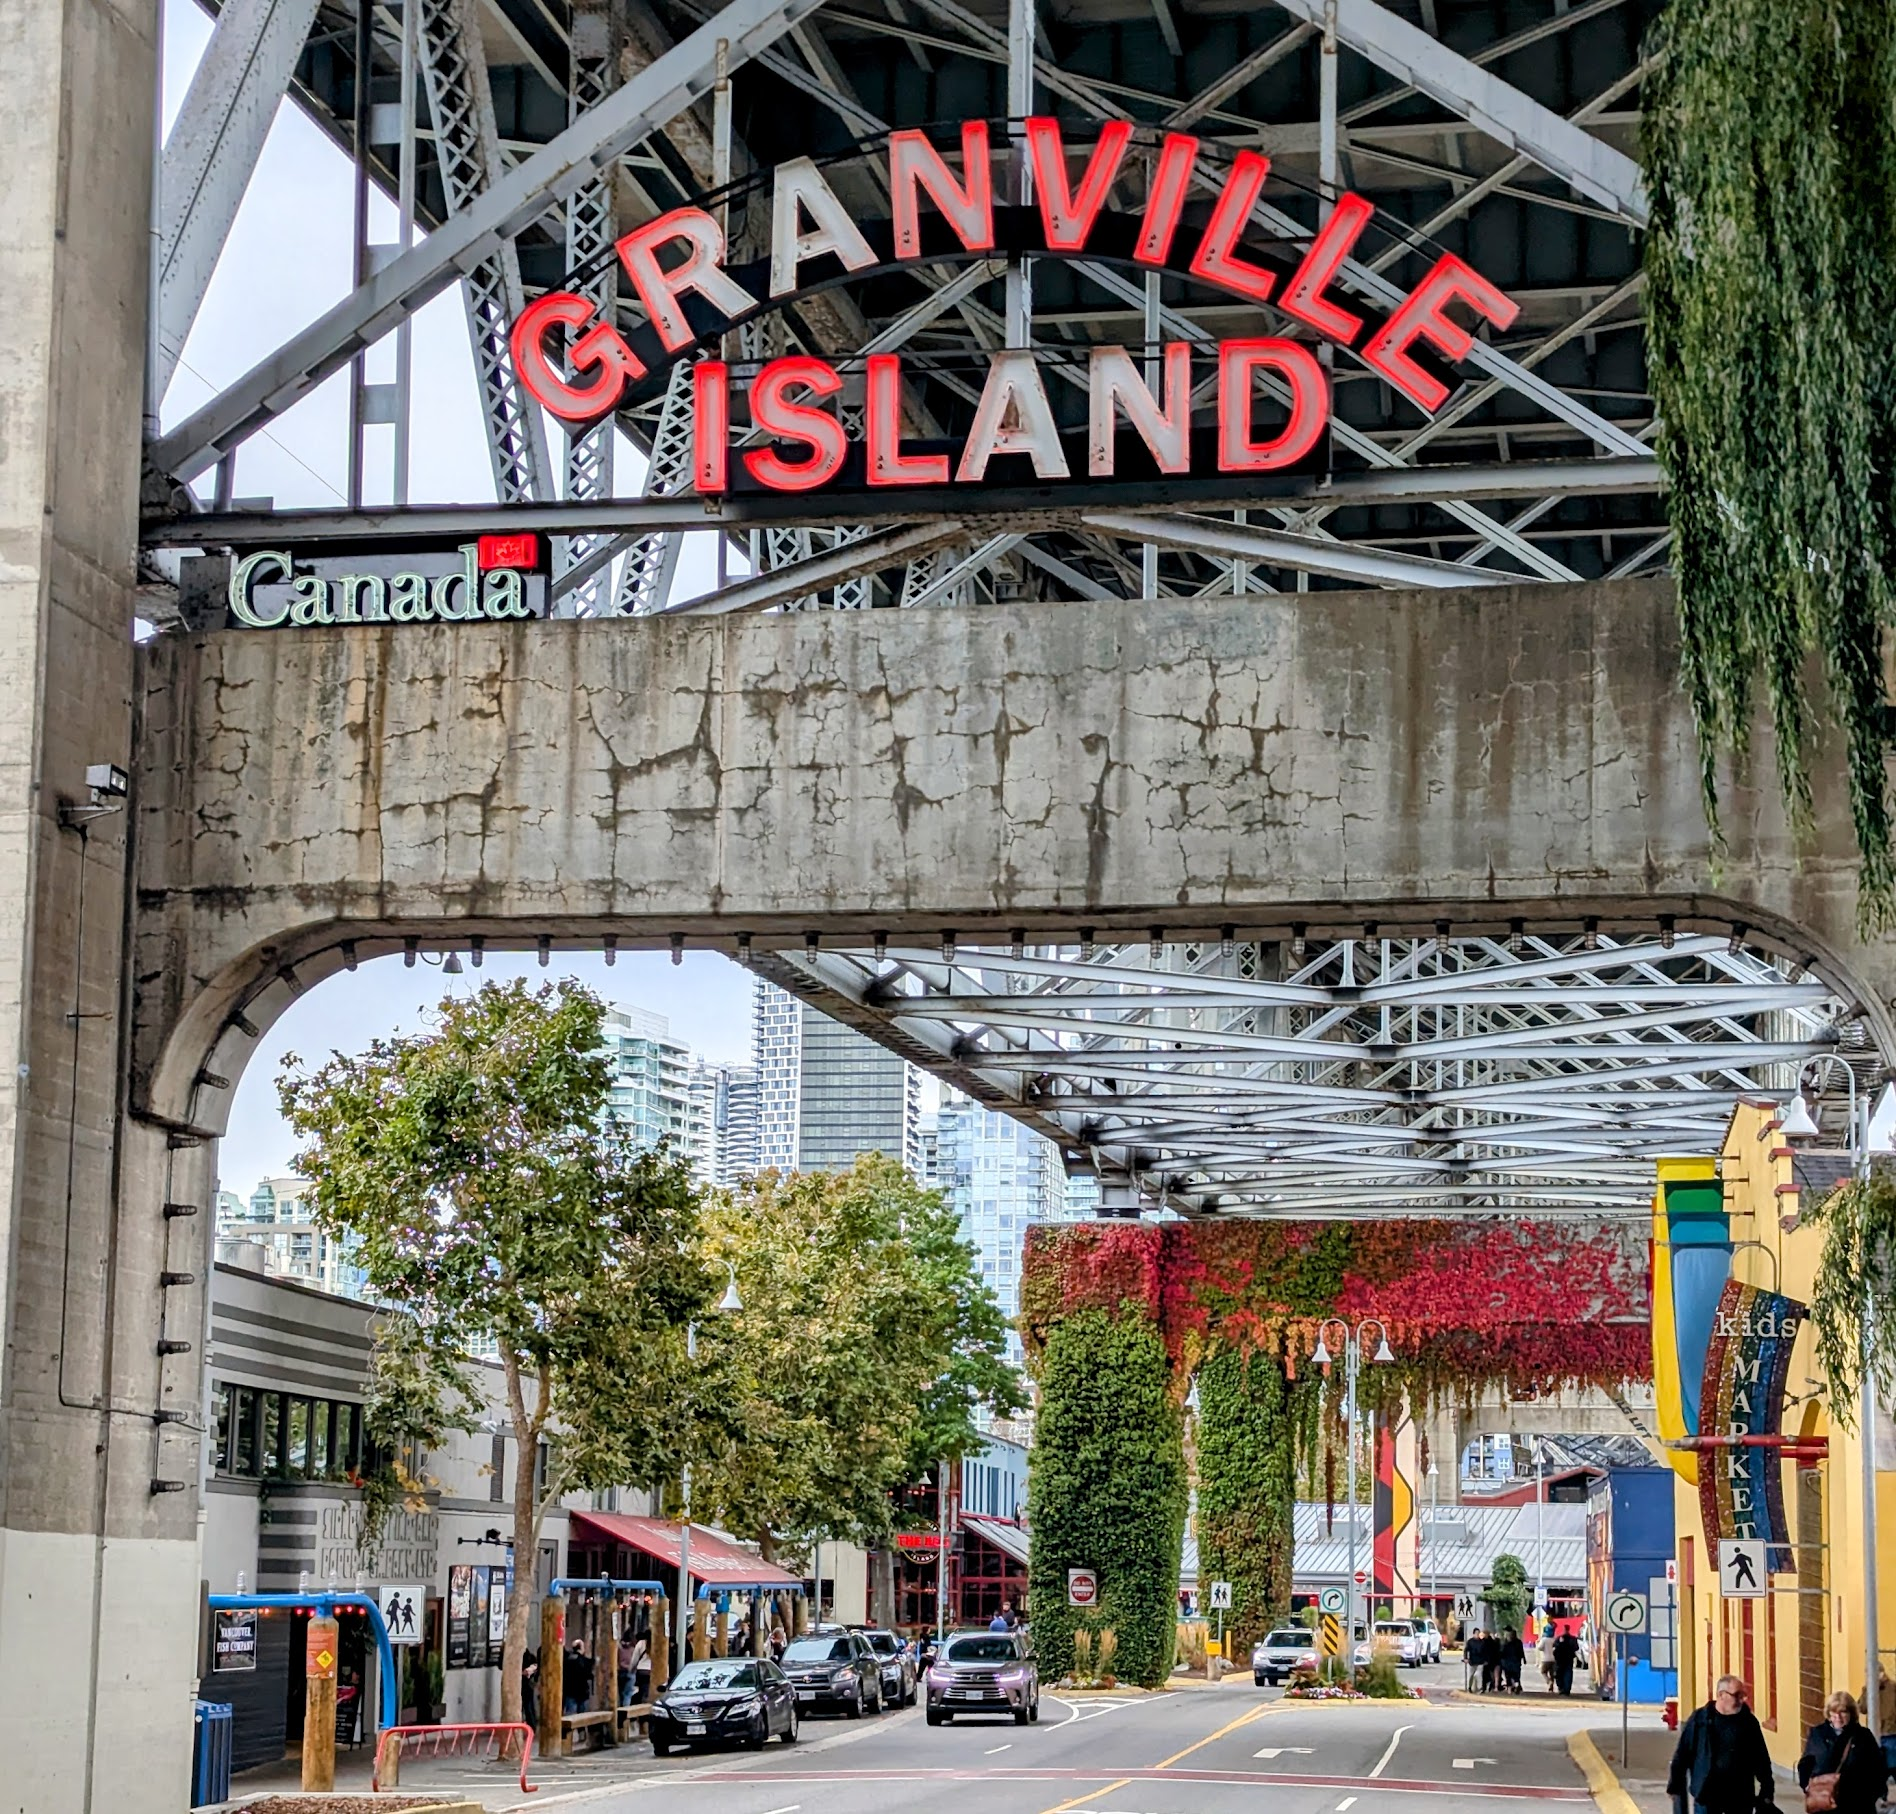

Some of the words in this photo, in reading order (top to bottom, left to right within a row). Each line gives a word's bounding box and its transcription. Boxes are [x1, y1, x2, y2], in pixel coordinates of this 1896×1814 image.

[510, 117, 1521, 424] GRANVILLE
[693, 337, 1330, 493] ISLAND
[229, 542, 530, 628] Canada
[1716, 1310, 1798, 1339] kids
[1629, 1416, 1653, 1439] LIFT
[1727, 1355, 1763, 1540] MARKET
[216, 1641, 230, 1653] FISH
[230, 1640, 254, 1652] COMPANY
